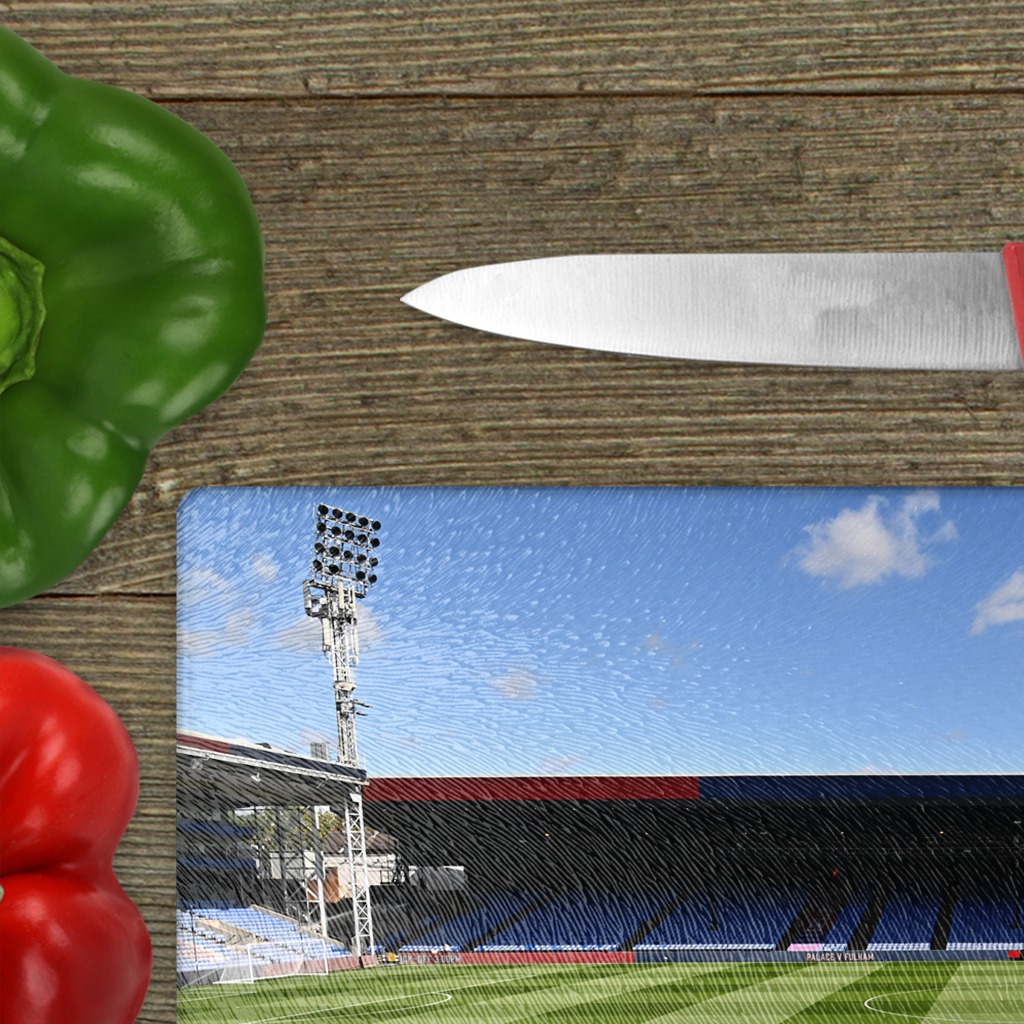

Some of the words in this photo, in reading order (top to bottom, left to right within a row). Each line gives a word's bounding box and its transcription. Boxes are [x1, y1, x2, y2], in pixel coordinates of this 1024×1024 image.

[398, 955, 432, 963] ICK-OFF
[806, 953, 835, 961] PALACE
[844, 953, 875, 961] FULHAM
